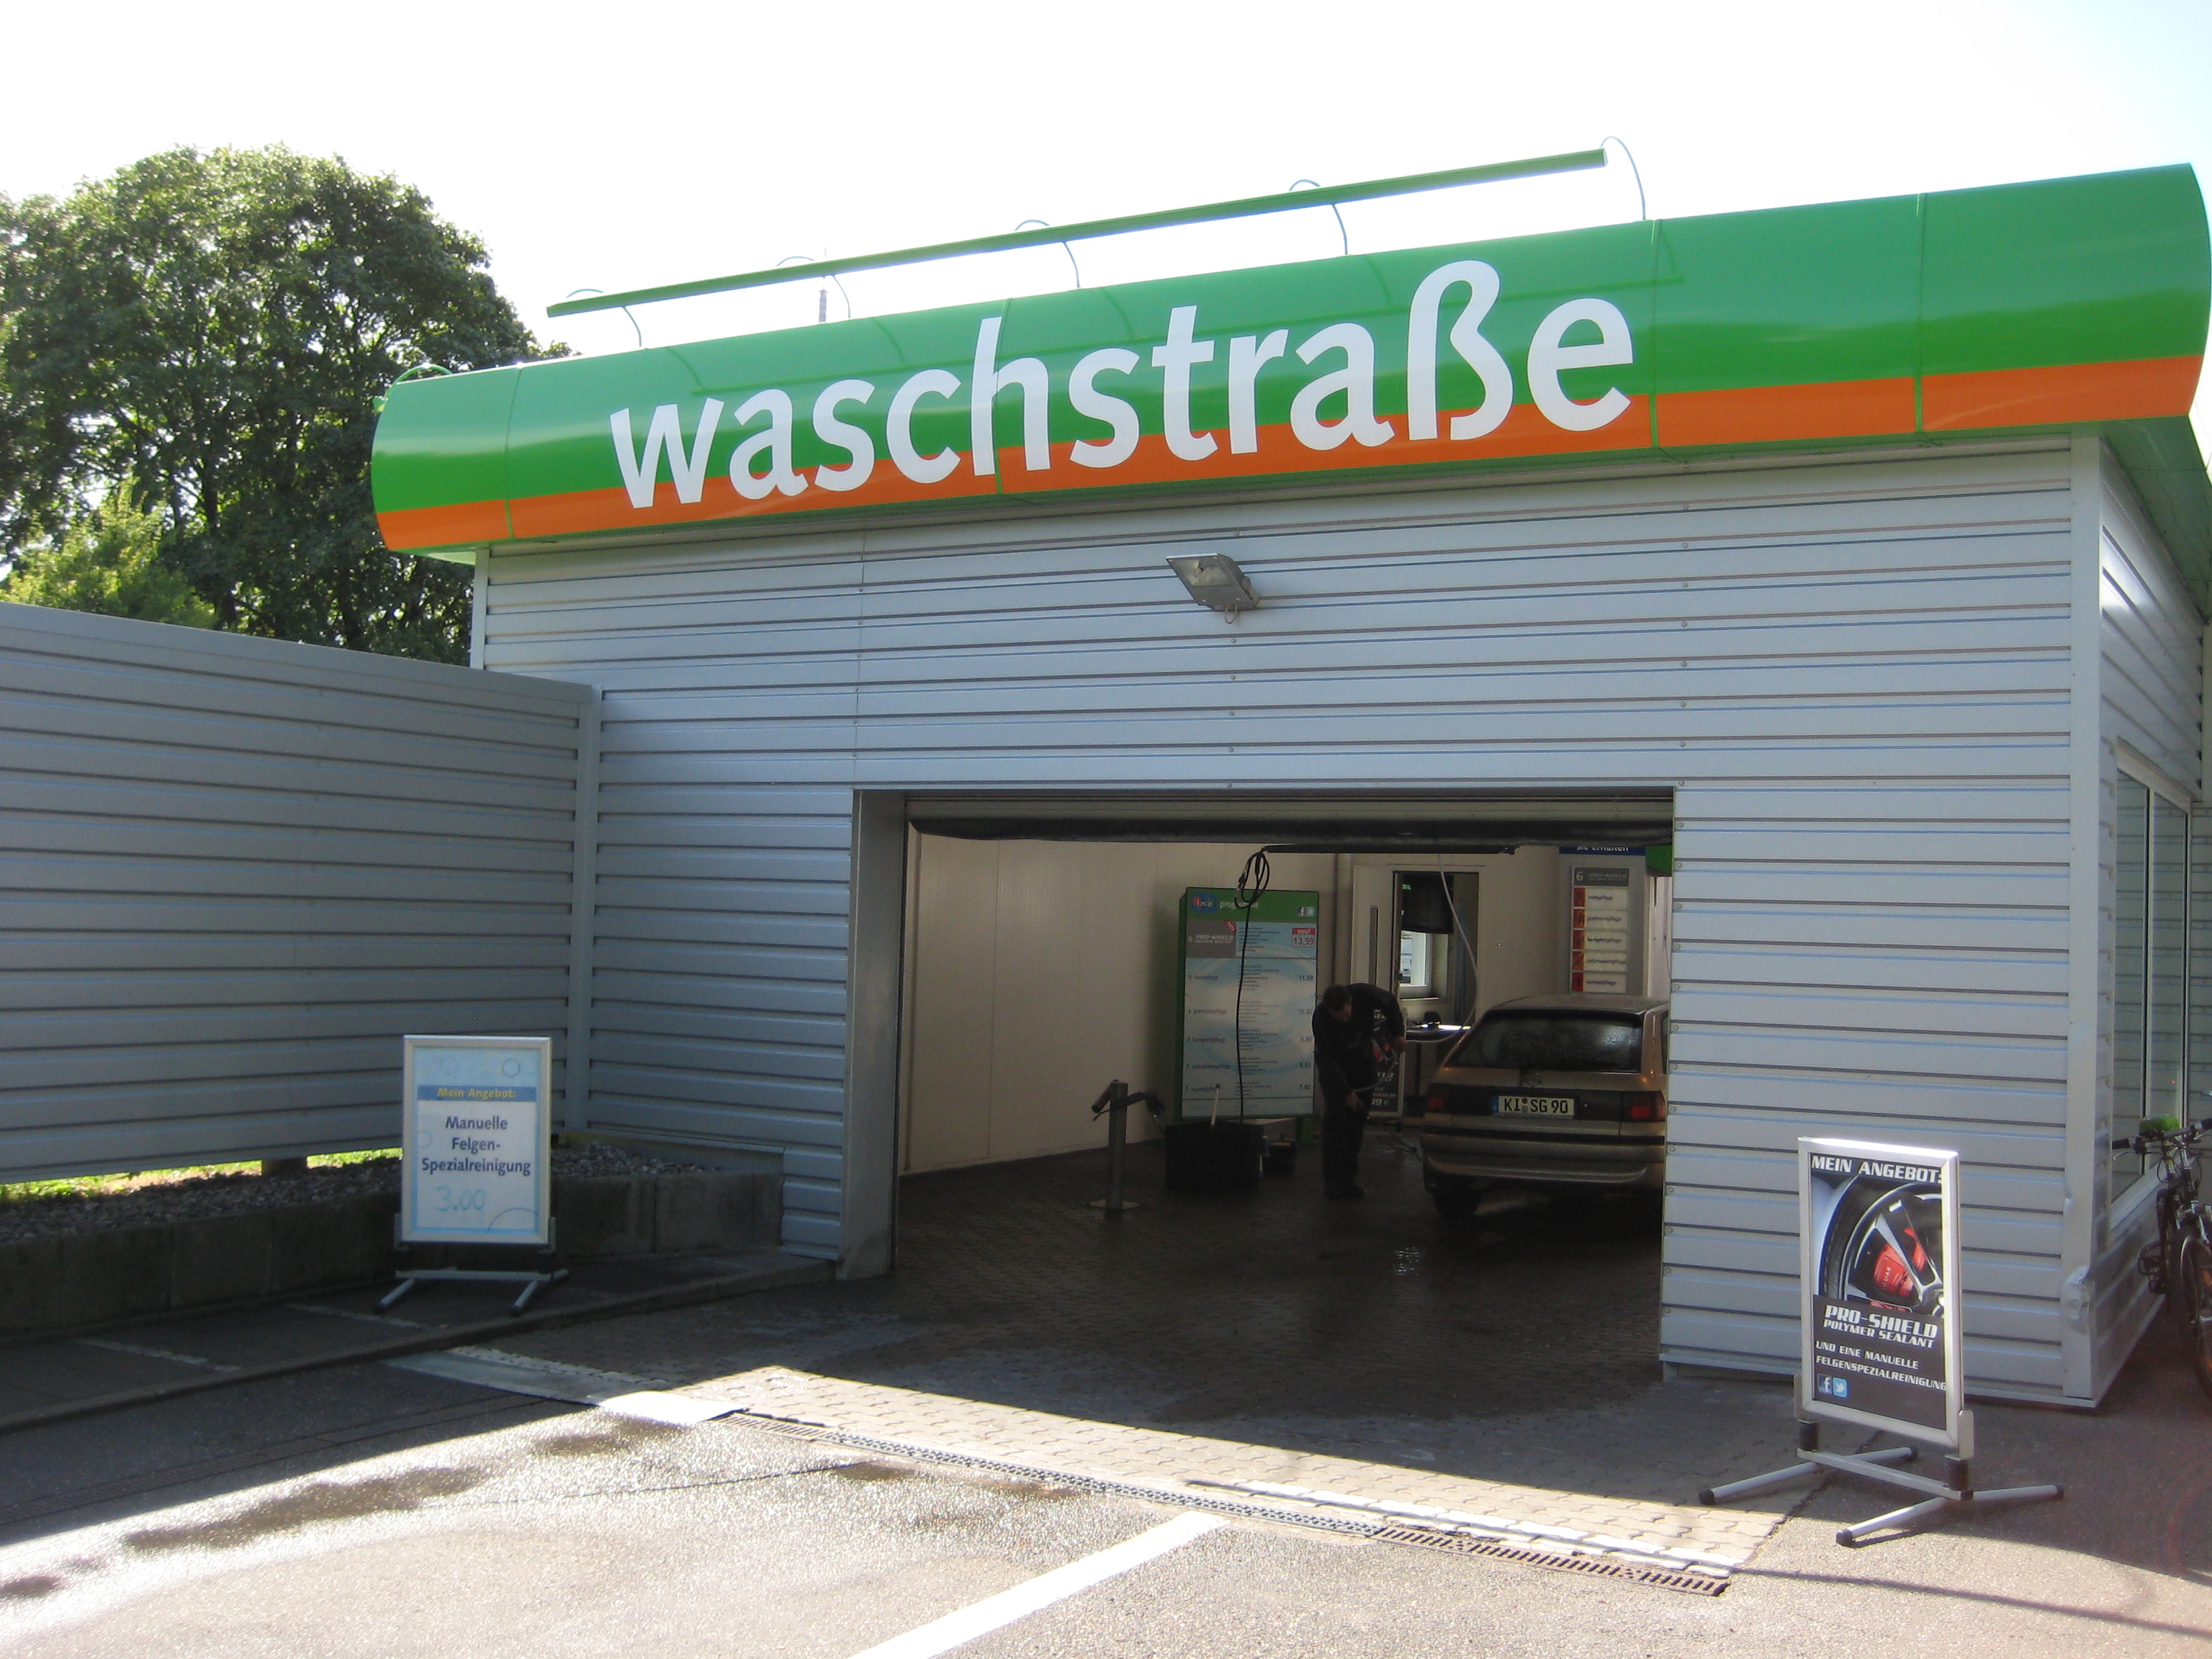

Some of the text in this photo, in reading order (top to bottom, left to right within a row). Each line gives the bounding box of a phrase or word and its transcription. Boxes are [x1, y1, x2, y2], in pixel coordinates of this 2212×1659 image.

[610, 259, 1633, 508] waschstraße
[1575, 871, 1583, 881] 6
[1293, 937, 1314, 945] 13.99
[437, 1088, 516, 1101] Mein Angebot:
[1504, 1098, 1568, 1114] KI SG 90
[445, 1115, 508, 1130] Manuelle
[452, 1136, 500, 1155] Felgen-
[421, 1157, 531, 1177] Spezialreinigung
[1812, 1155, 1853, 1174] MEIN
[435, 1186, 486, 1212] 3.00
[1824, 1304, 1938, 1339] PRO-SHIELD
[1823, 1318, 1936, 1349] POLYMER SEALANT
[1816, 1340, 1920, 1370] UND EINE MANUELLE
[1815, 1354, 1946, 1391] FELGENSPEZIALREINIGUNG
